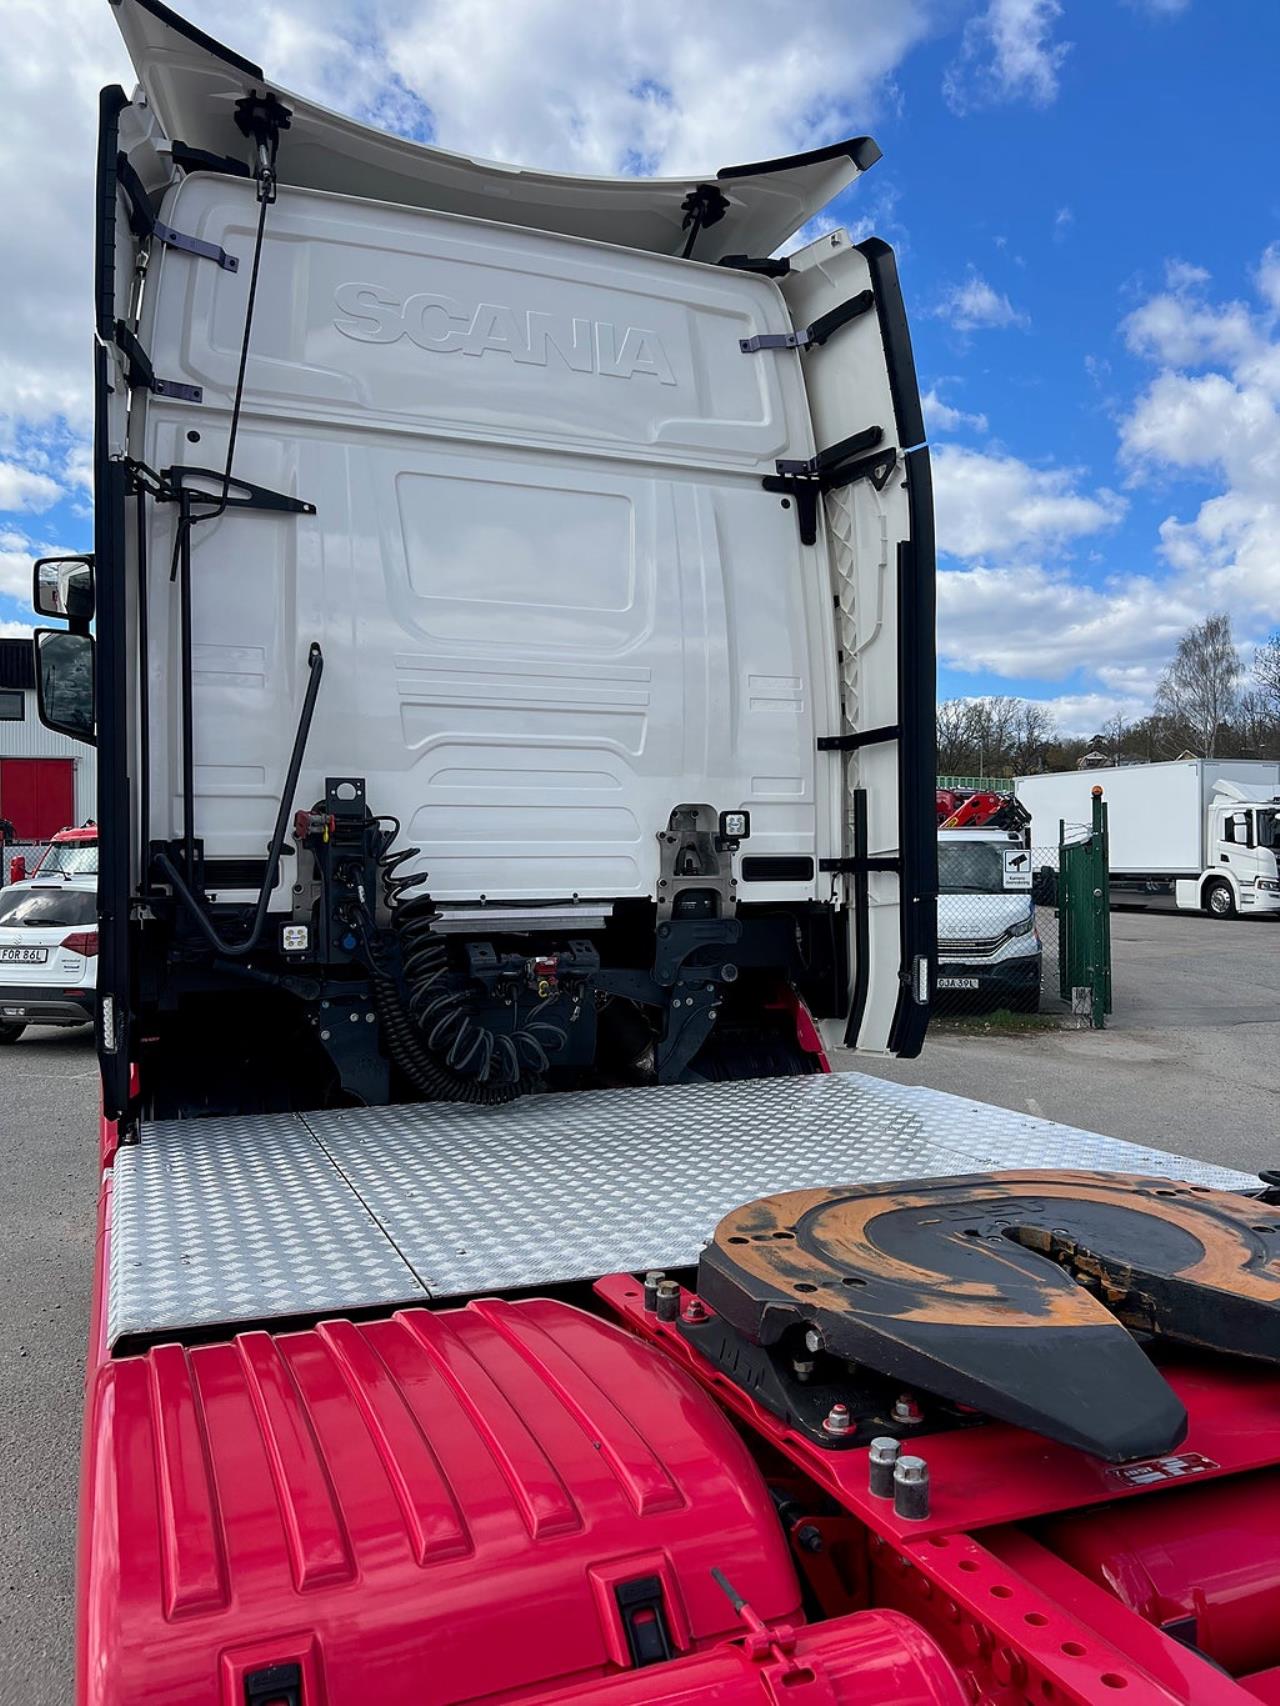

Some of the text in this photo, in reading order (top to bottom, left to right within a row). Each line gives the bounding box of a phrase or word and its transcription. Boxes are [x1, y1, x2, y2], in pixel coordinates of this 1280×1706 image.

[334, 282, 677, 386] SCANIA
[2, 949, 42, 960] FOR 86L
